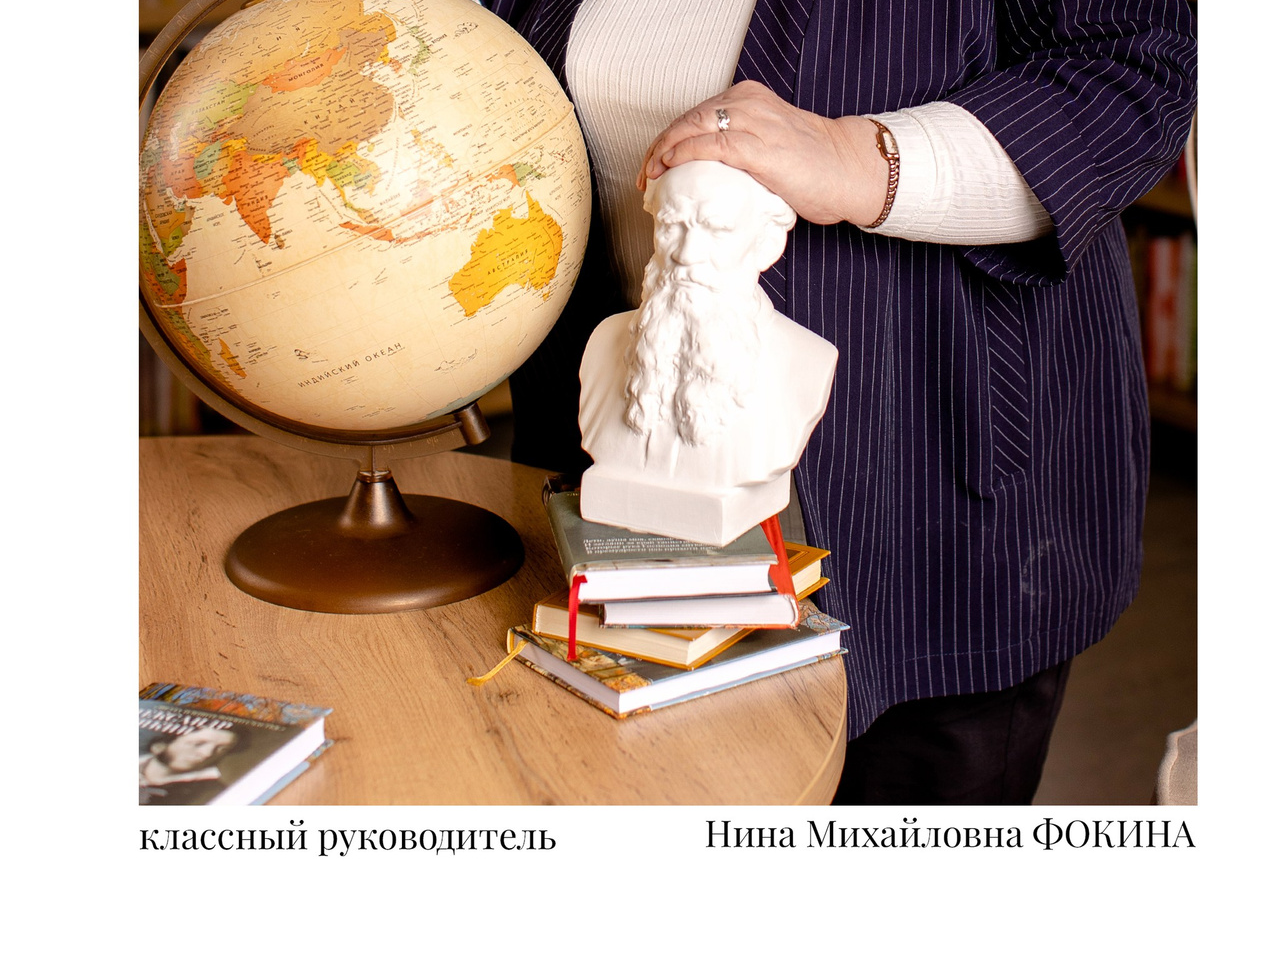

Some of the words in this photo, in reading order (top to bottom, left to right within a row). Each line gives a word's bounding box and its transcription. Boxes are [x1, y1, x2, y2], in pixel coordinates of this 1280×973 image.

[288, 63, 324, 82] МОНГОЛИЯ
[304, 98, 356, 126] КИТАЙ
[246, 195, 268, 207] ИНДИЯ
[487, 249, 529, 276] АВСТРАЛИЯ
[298, 360, 361, 388] ИНДИЙСКИЙ
[365, 342, 402, 362] ОКЕАН
